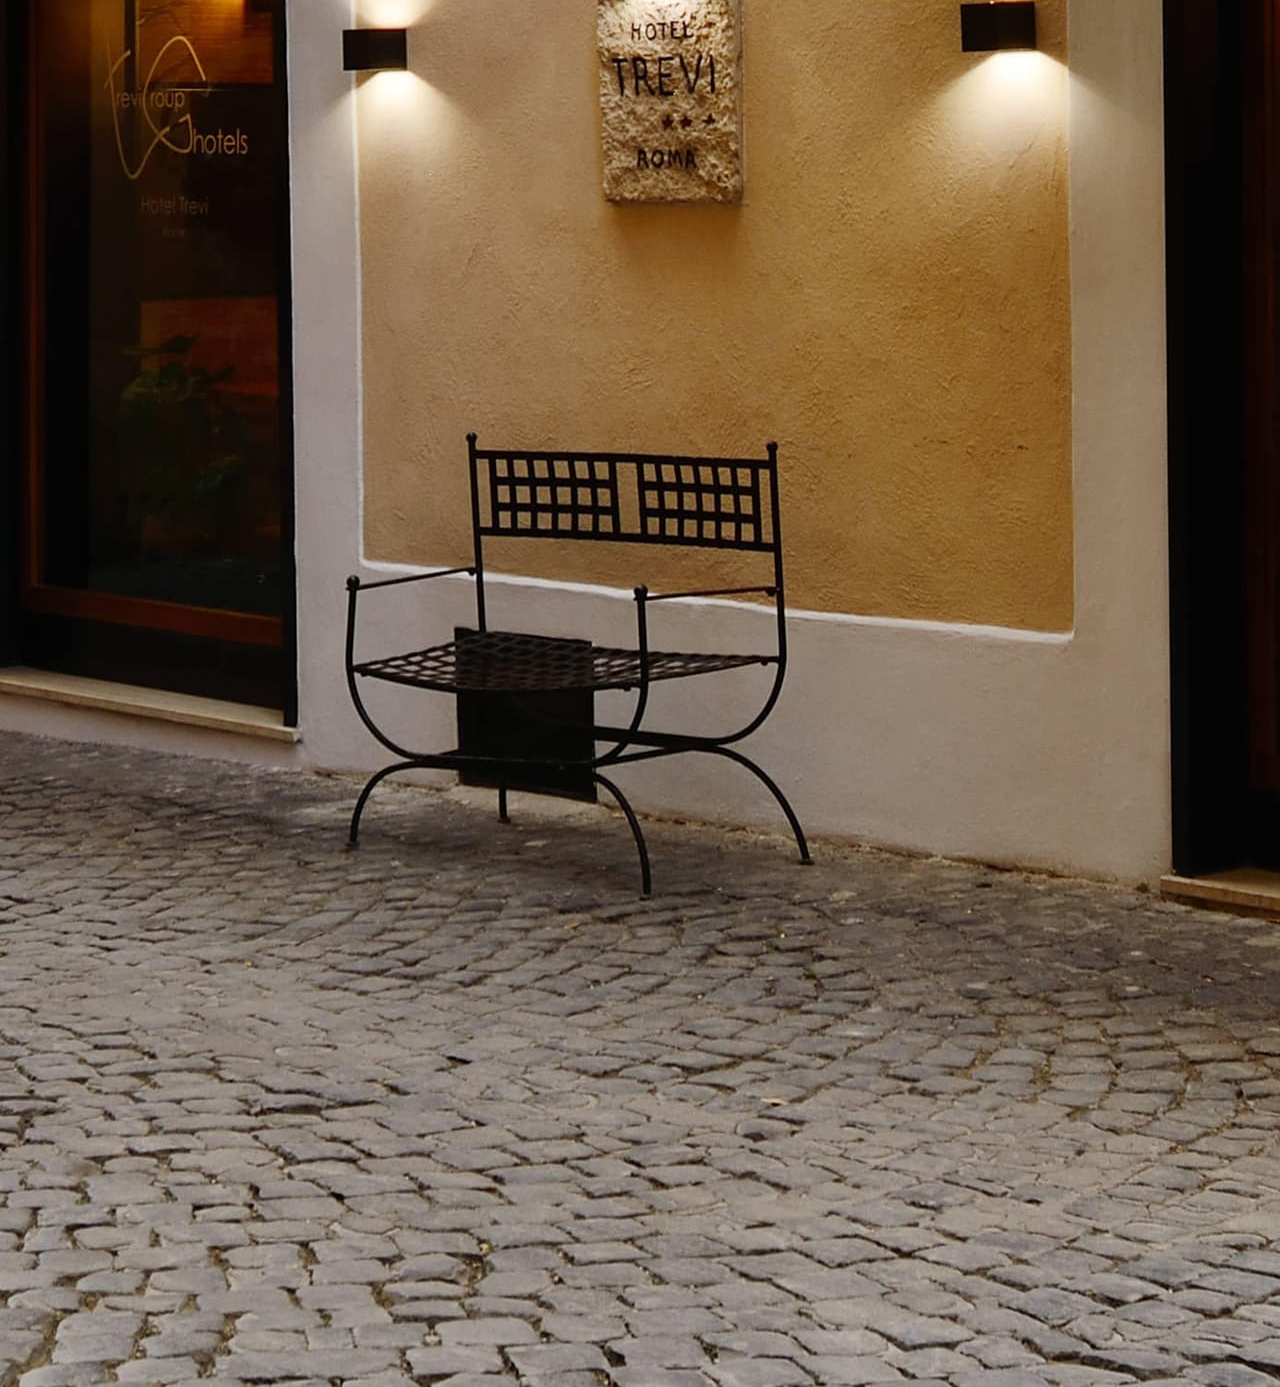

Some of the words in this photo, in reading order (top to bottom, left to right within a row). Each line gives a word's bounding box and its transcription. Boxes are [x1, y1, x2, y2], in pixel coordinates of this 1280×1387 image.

[631, 19, 695, 42] HOTEL
[611, 53, 717, 97] TREVI
[193, 128, 249, 156] hotels
[636, 148, 698, 169] ROMA
